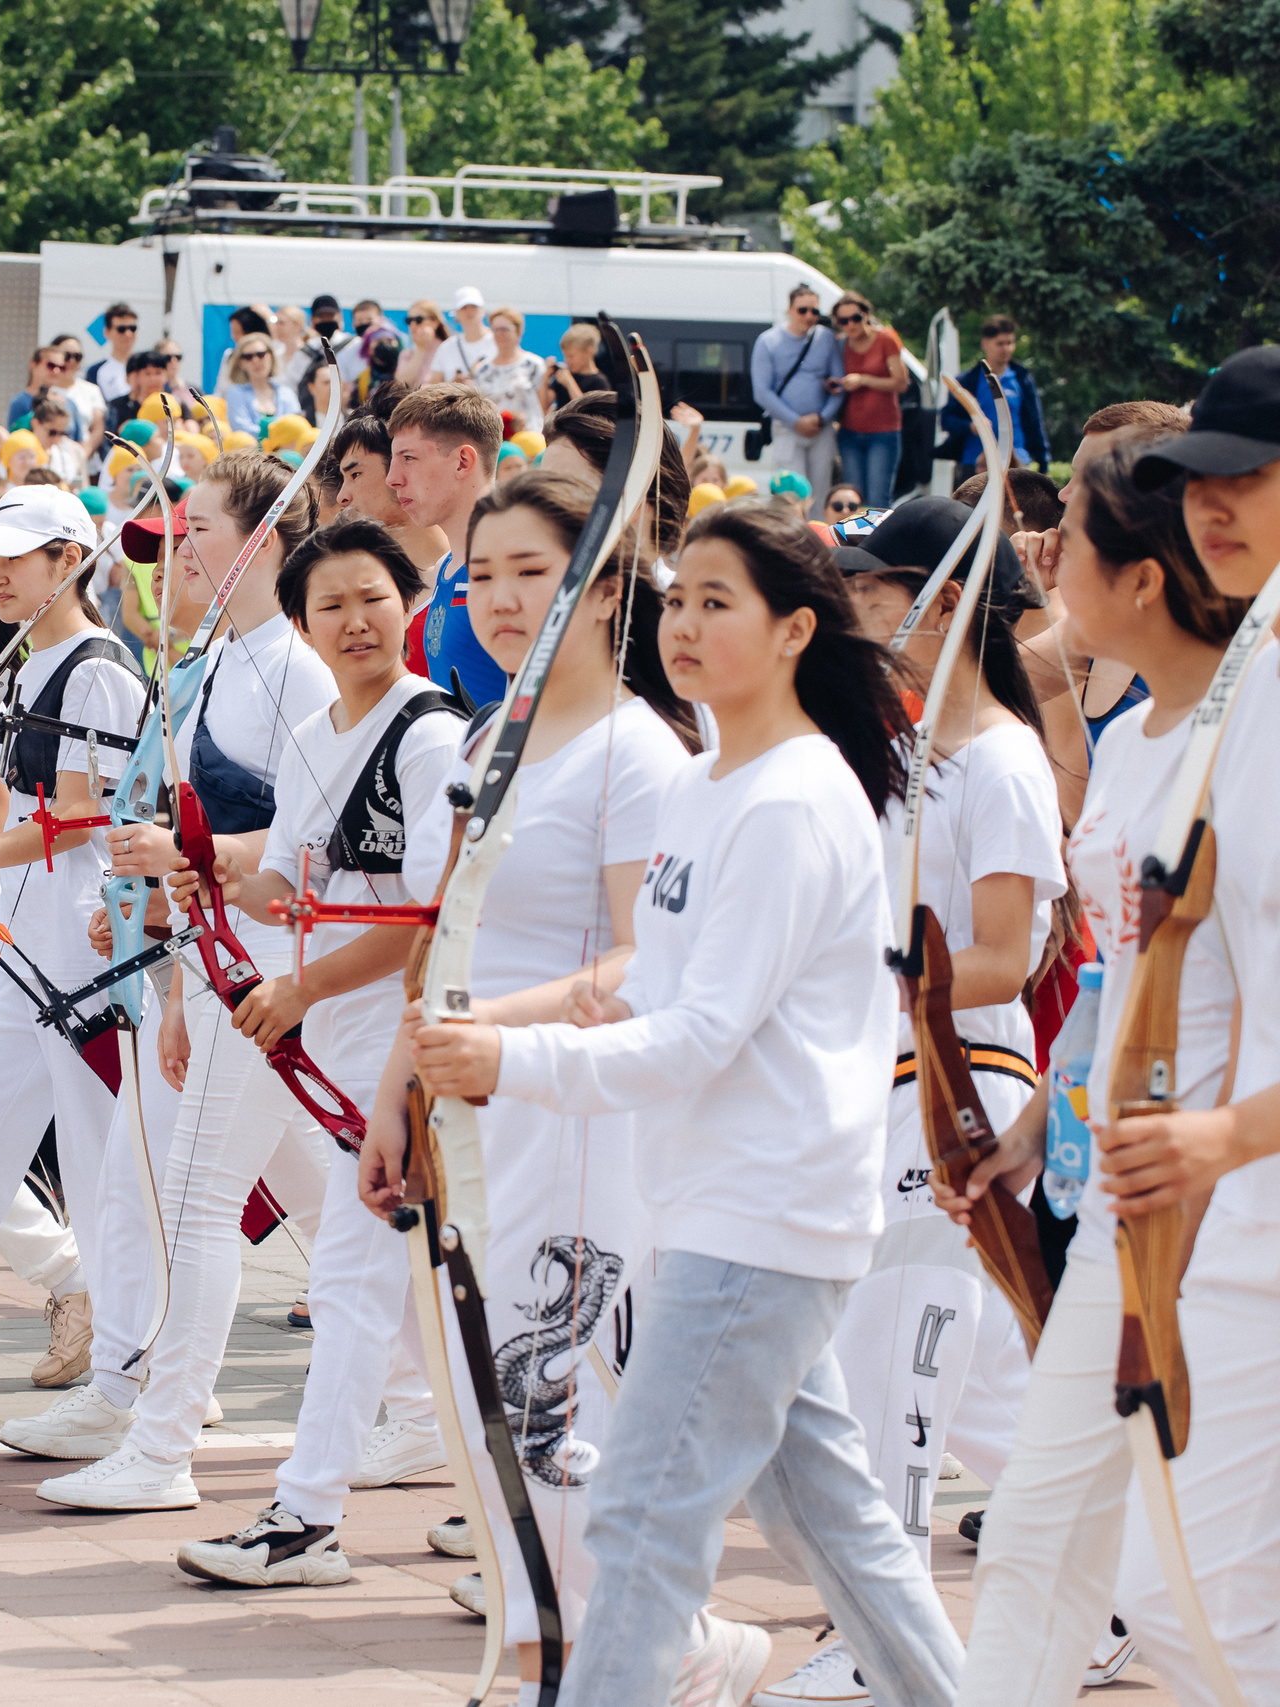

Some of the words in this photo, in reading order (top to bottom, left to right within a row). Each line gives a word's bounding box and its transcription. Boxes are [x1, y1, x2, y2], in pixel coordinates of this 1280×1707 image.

[698, 434, 733, 453] 77
[220, 563, 242, 599] CORE
[902, 1194, 933, 1203] AIR
